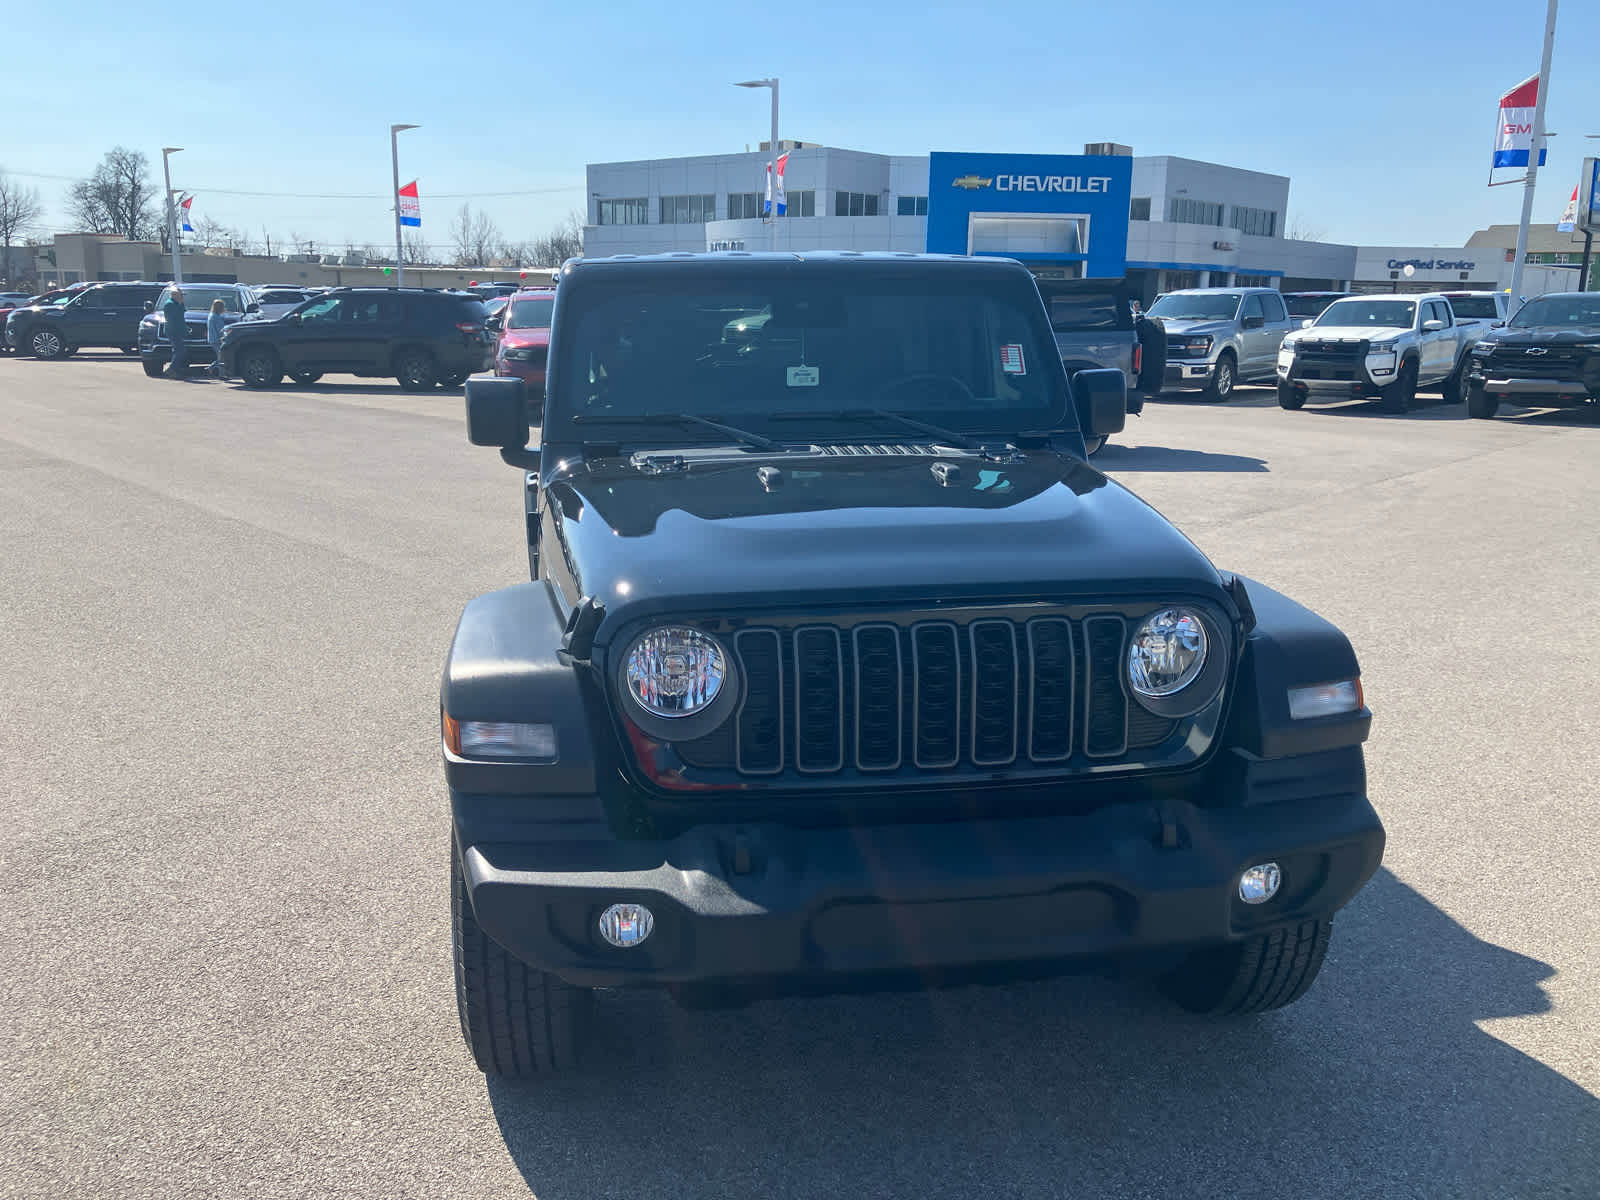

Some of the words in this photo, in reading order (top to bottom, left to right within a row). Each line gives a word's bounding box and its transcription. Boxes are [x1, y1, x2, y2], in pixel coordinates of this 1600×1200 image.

[1503, 123, 1532, 135] GM
[995, 174, 1112, 193] CHEVROLET
[1387, 258, 1434, 270] Certified
[1435, 259, 1475, 271] Service
